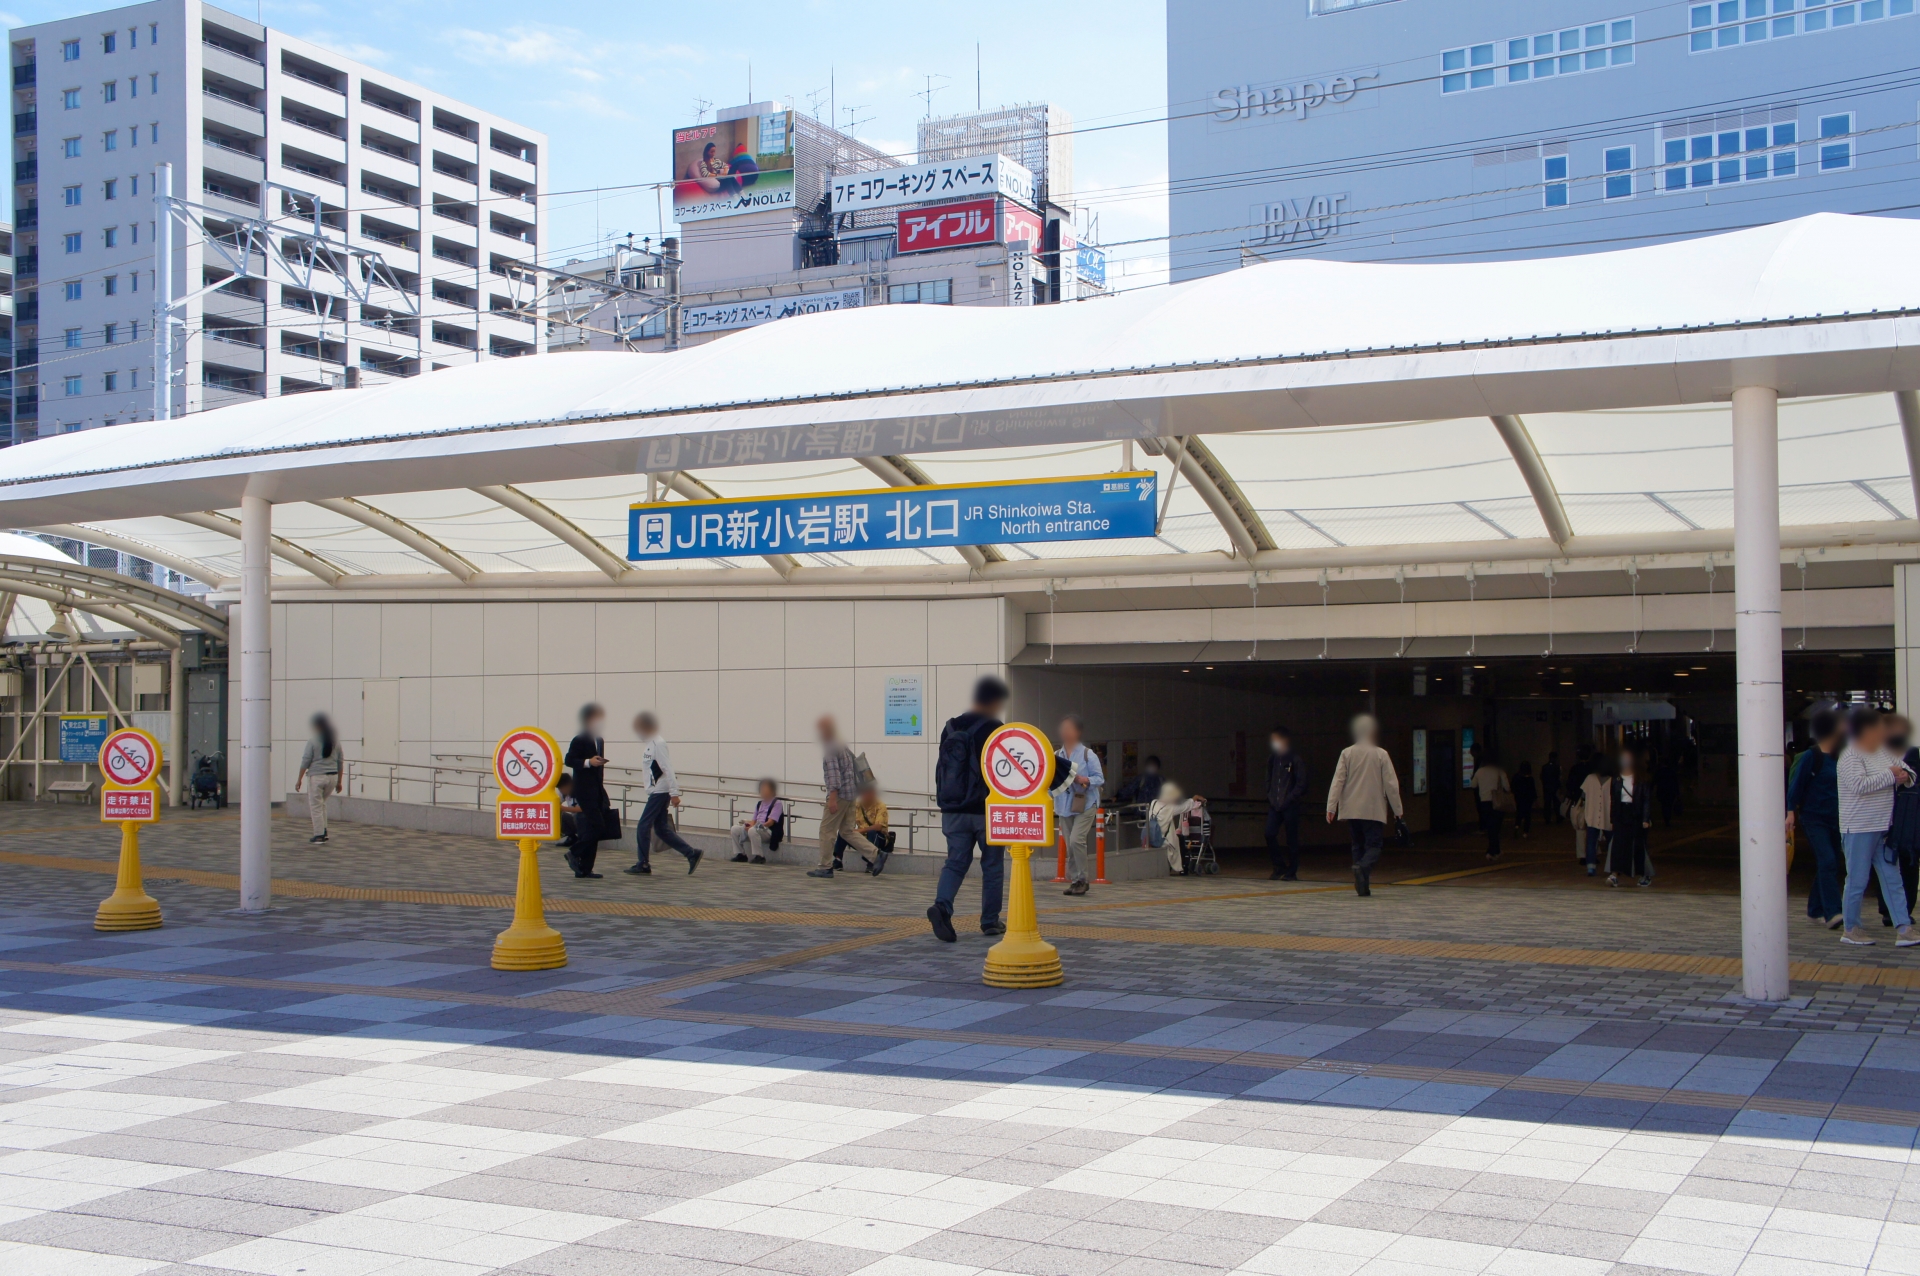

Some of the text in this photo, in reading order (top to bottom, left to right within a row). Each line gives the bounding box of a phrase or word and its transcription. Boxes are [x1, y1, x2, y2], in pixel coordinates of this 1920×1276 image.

[835, 163, 994, 203] 7F コワーキング スペース
[752, 191, 791, 206] NOLAZ
[674, 201, 732, 217] コワーキング スペース
[904, 209, 990, 243] アイフル
[1012, 252, 1024, 300] NOLAZ
[692, 304, 773, 327] コワーキング スペース
[964, 500, 1096, 521] JR Shinkoiwa Sta.
[676, 499, 958, 549] JR新小岩駅 北口
[1001, 518, 1110, 535] North entrance
[107, 795, 150, 806] 走行禁止
[502, 807, 549, 819] 走行禁止
[992, 811, 1042, 824] 走行禁止
[992, 826, 1042, 836] 自転車は降りてください
